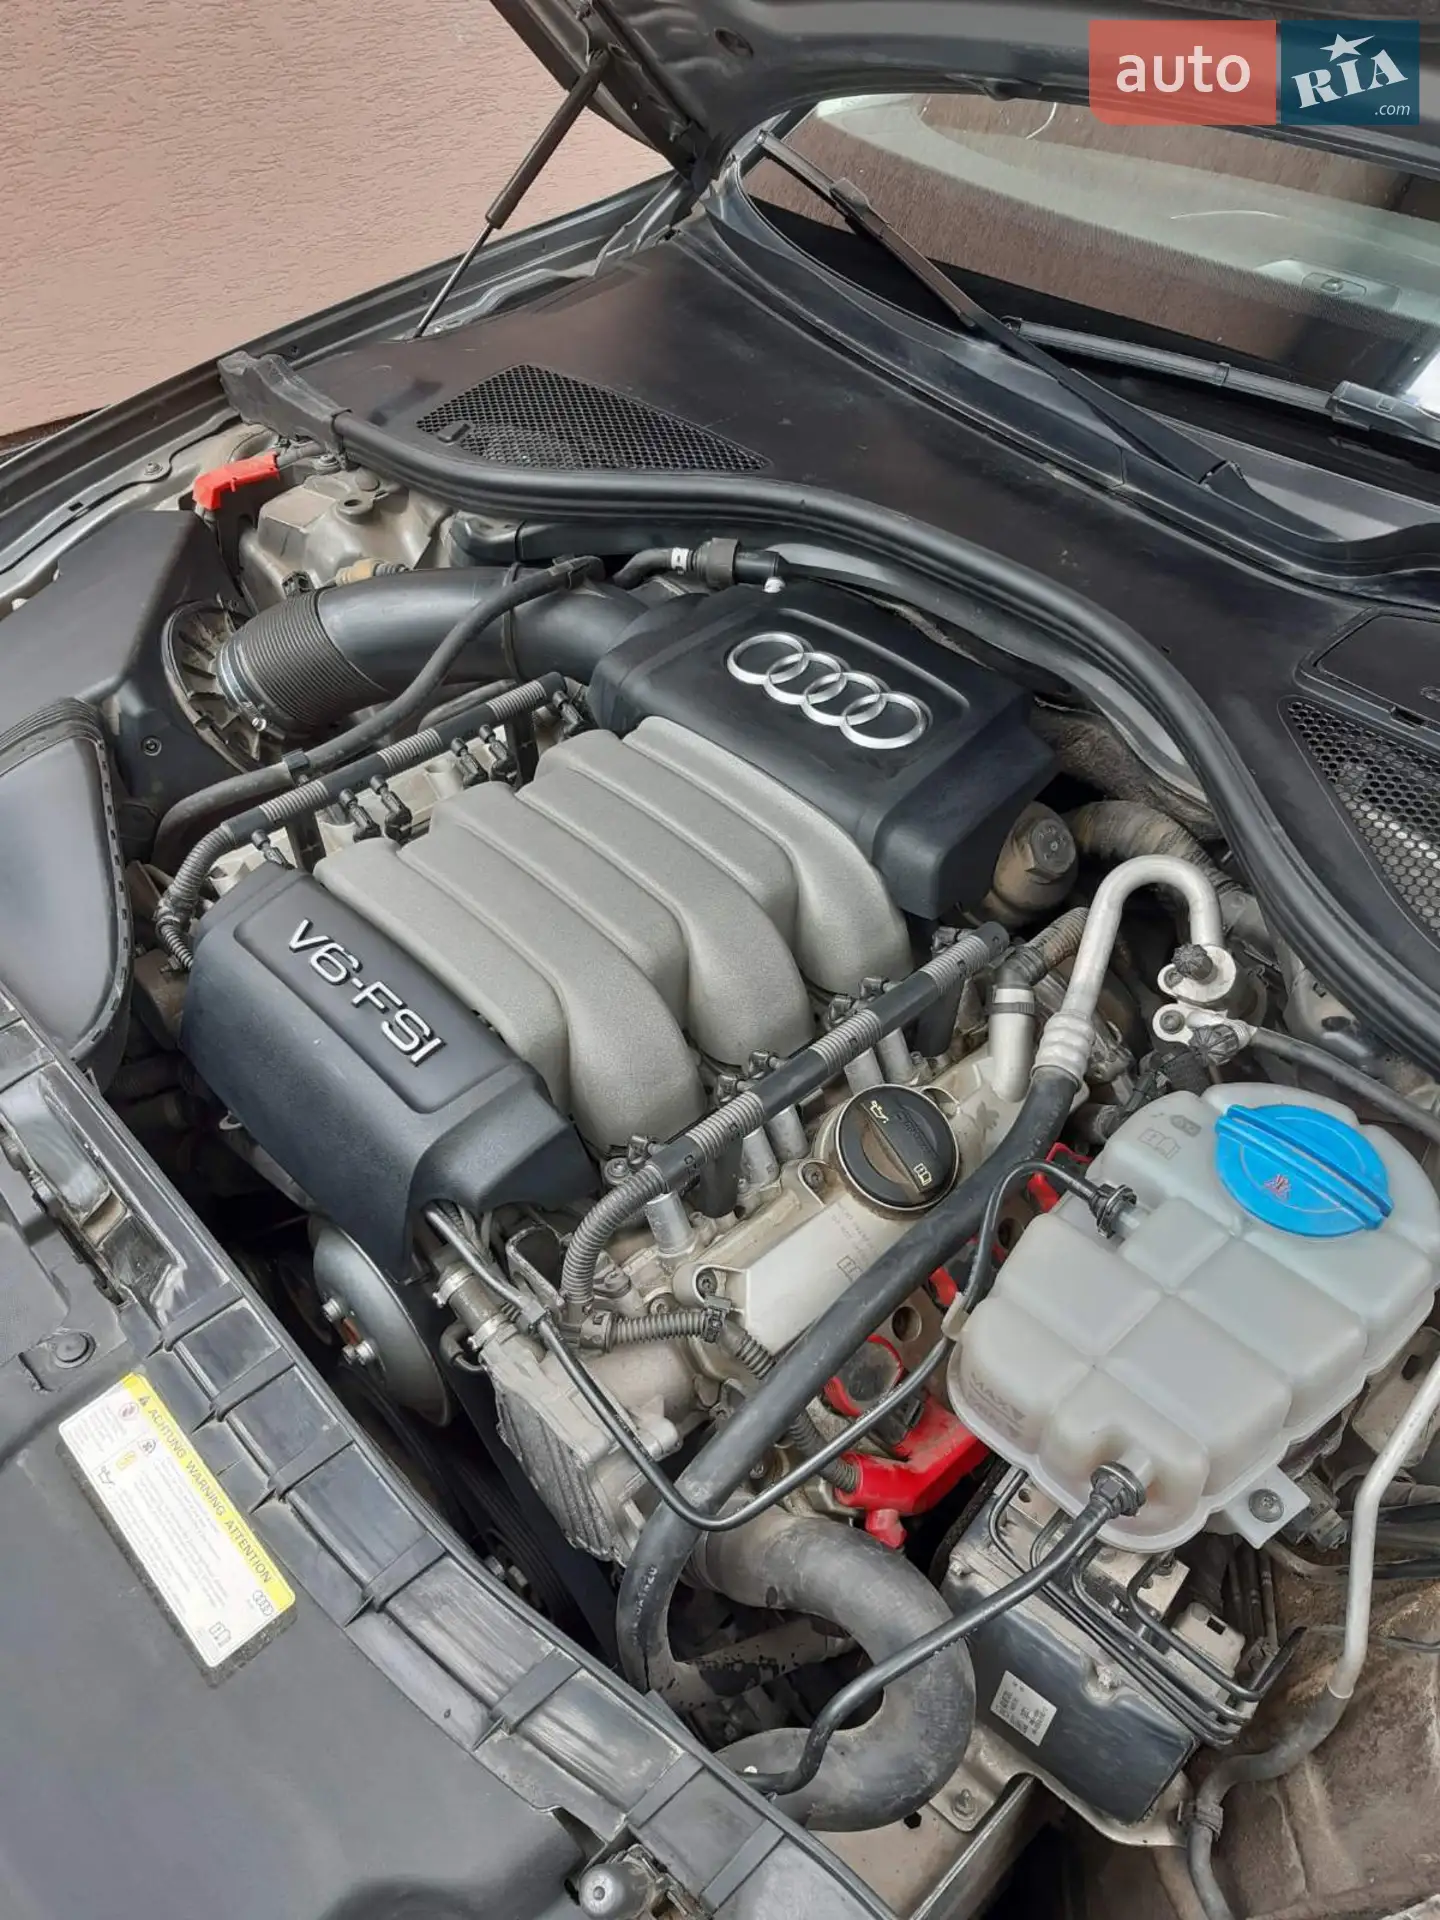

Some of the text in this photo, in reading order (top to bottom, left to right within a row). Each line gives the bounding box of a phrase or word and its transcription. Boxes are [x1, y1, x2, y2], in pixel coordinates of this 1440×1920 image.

[289, 918, 444, 1064] V6-FSI
[148, 1408, 187, 1459] ACHTUNG
[186, 1459, 226, 1516] WARNING
[224, 1519, 272, 1584] ATTENTION
